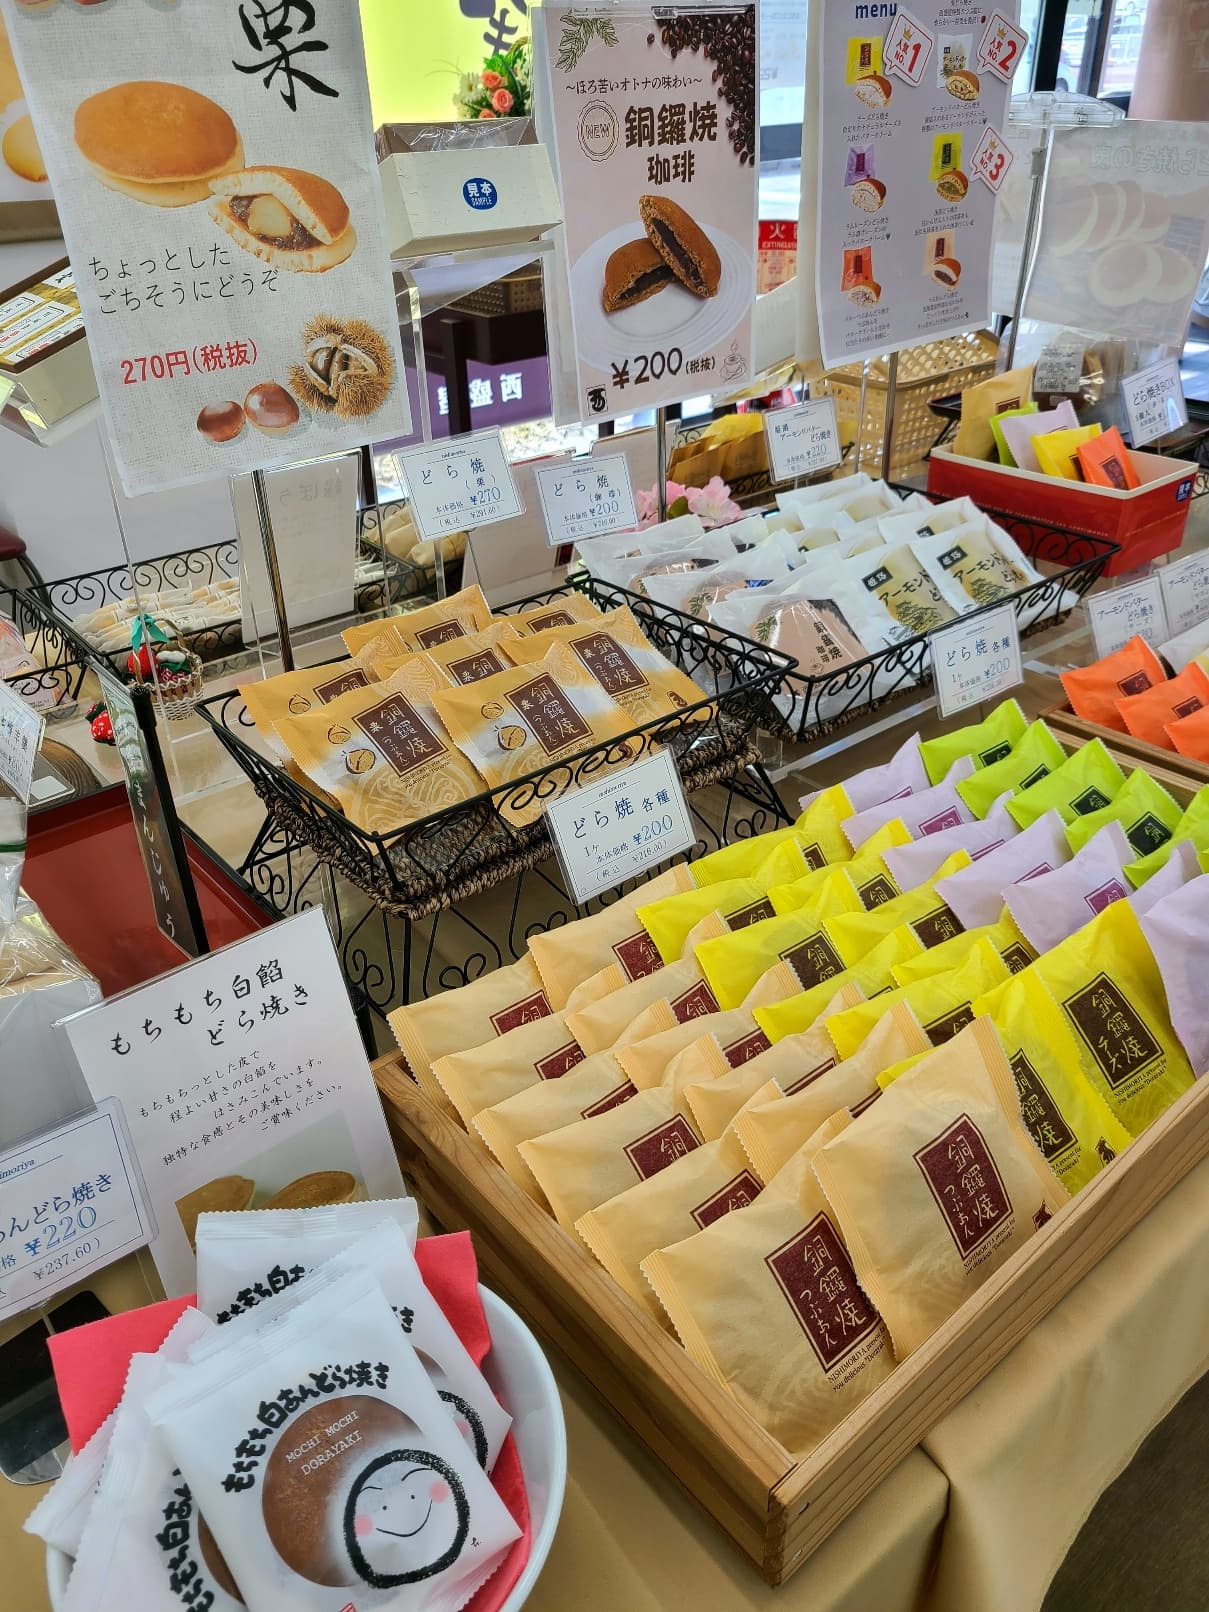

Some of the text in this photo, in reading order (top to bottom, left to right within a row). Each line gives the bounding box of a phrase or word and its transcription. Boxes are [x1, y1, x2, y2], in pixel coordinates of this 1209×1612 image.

[855, 2, 897, 19] menu
[908, 42, 922, 73] 1
[998, 40, 1017, 72] 2
[585, 122, 611, 140] NEW
[624, 100, 718, 149] 銅鑼焼
[466, 181, 492, 197] 見本
[647, 150, 695, 186] 珈琲
[989, 154, 1005, 181] 3
[89, 243, 231, 281] ちょっとした
[99, 269, 278, 314] ごちそうにどうぞ
[120, 338, 257, 385] 270円(税抜)
[381, 703, 433, 758] 銅鑼焼
[642, 788, 671, 813] 各種
[632, 814, 673, 845] ¥200
[110, 959, 283, 1055] もちもち白餡
[207, 984, 308, 1045] どら焼き
[1092, 988, 1148, 1064] 銅鑼焼
[169, 1061, 276, 1124] 程よい甘さの白餡を
[163, 1078, 313, 1166] 独特な食感とその美味しさを
[948, 1135, 999, 1228] 銅鑼焼
[24, 1206, 97, 1257] ¥220
[944, 1184, 974, 1239] つぶあん
[804, 1235, 867, 1335] 銅鑼焼
[800, 1289, 838, 1350] つぶあん
[221, 1360, 389, 1493] もちもち白あんどら焼き
[285, 1410, 359, 1463] MOCHI MOCHI
[300, 1430, 362, 1476] DORAYAKI
